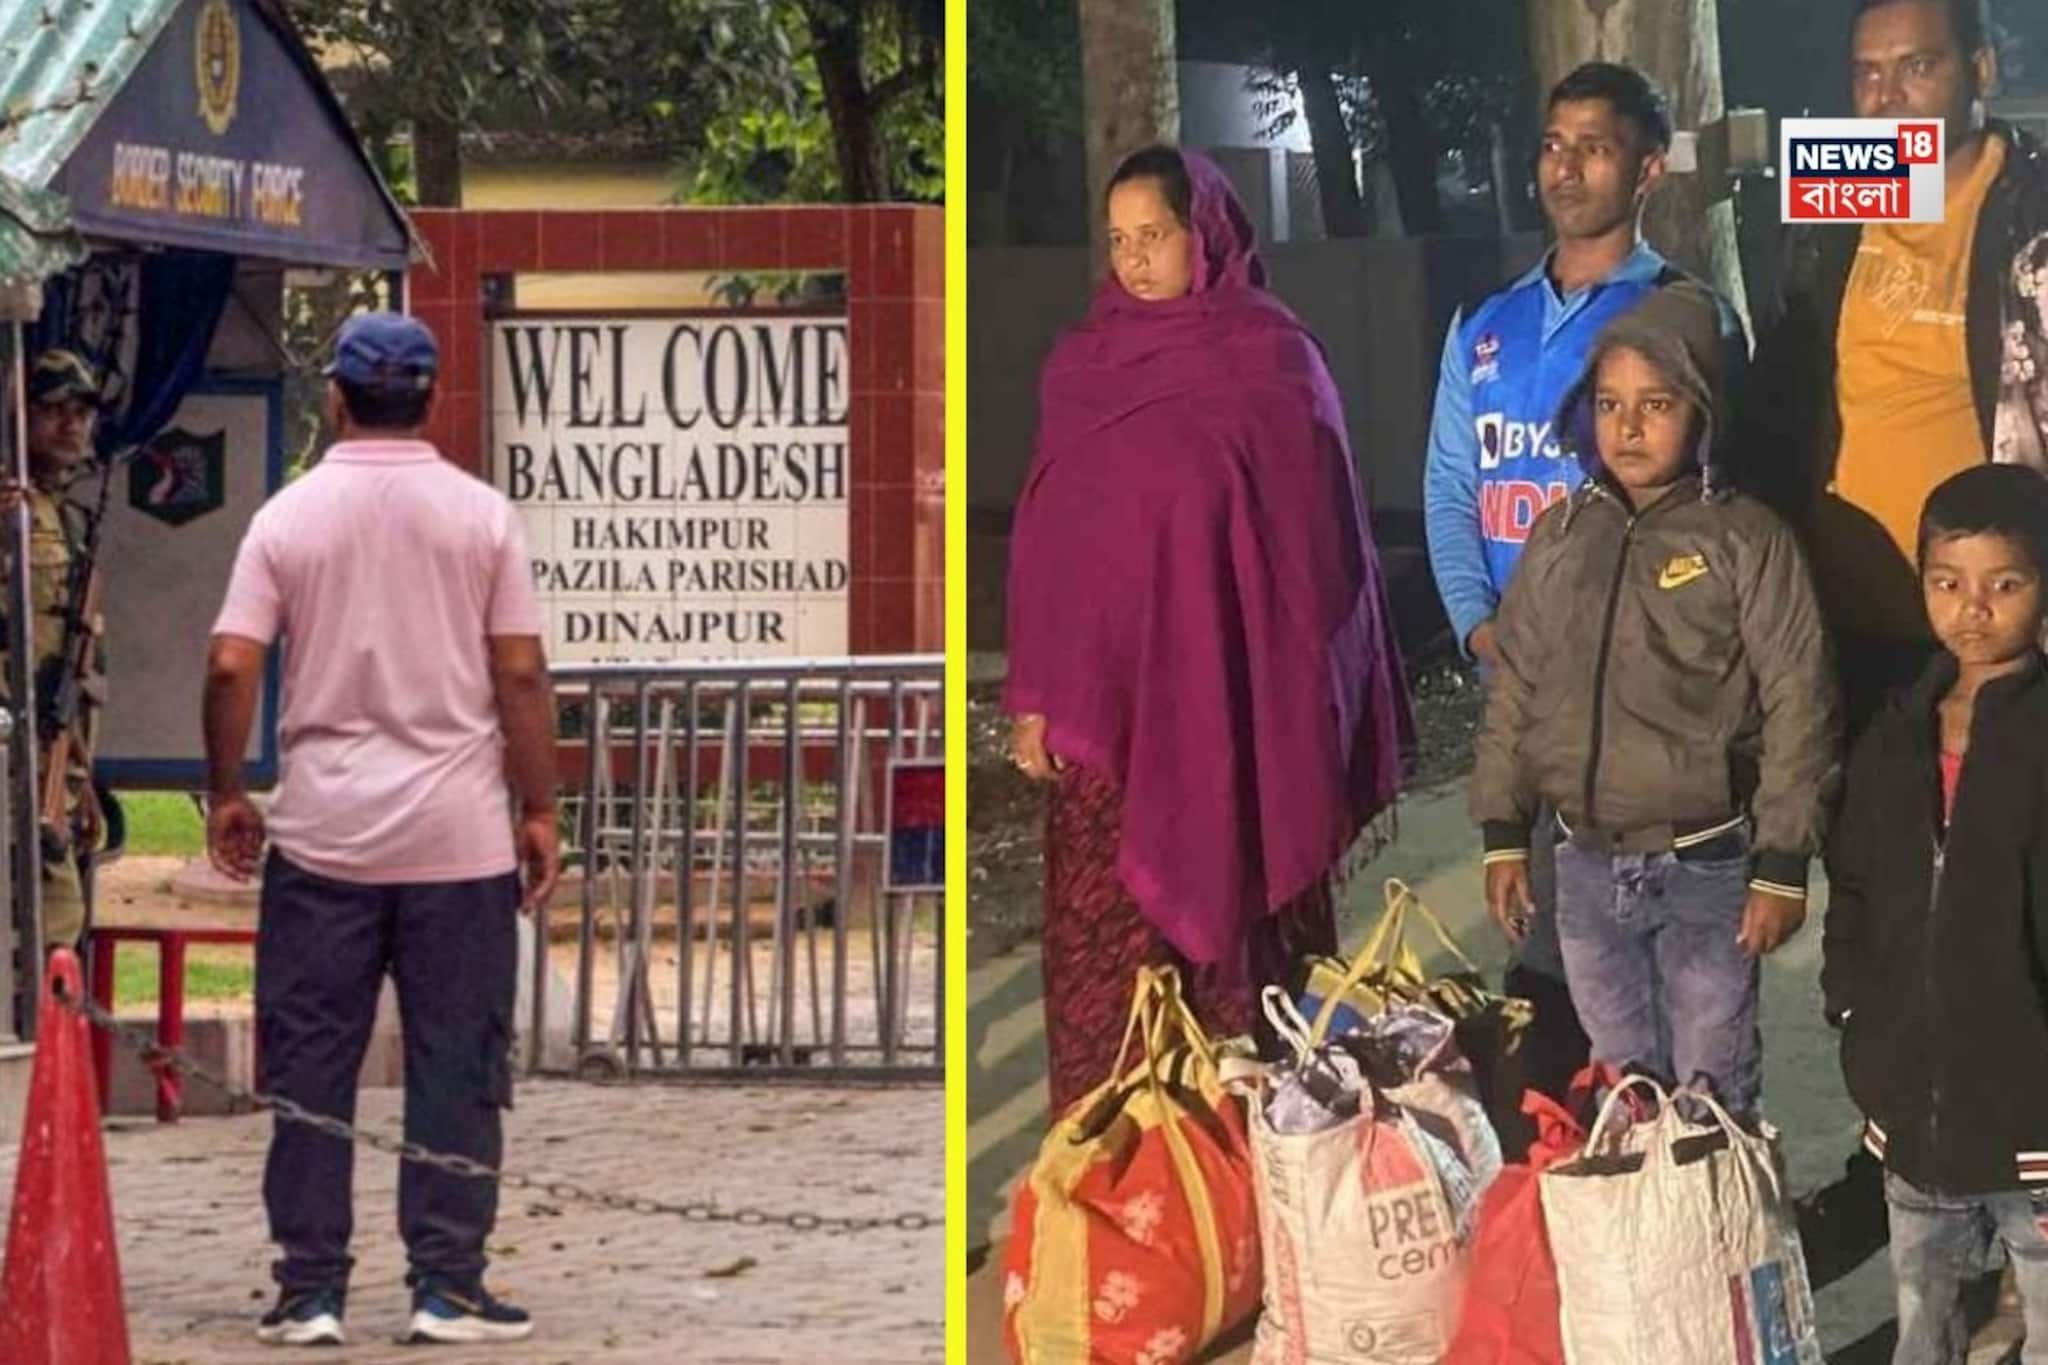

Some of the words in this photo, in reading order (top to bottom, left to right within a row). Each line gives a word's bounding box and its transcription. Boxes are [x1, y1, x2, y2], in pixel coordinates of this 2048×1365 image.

[176, 151, 245, 219] SECURITY
[252, 162, 304, 225] FORCE
[506, 441, 847, 502] BANGLADESH
[572, 517, 771, 550] HAKIMPUR
[531, 560, 656, 592] PAZILA
[668, 559, 848, 592] PARISHAD
[565, 611, 785, 643] DINAJPUR
